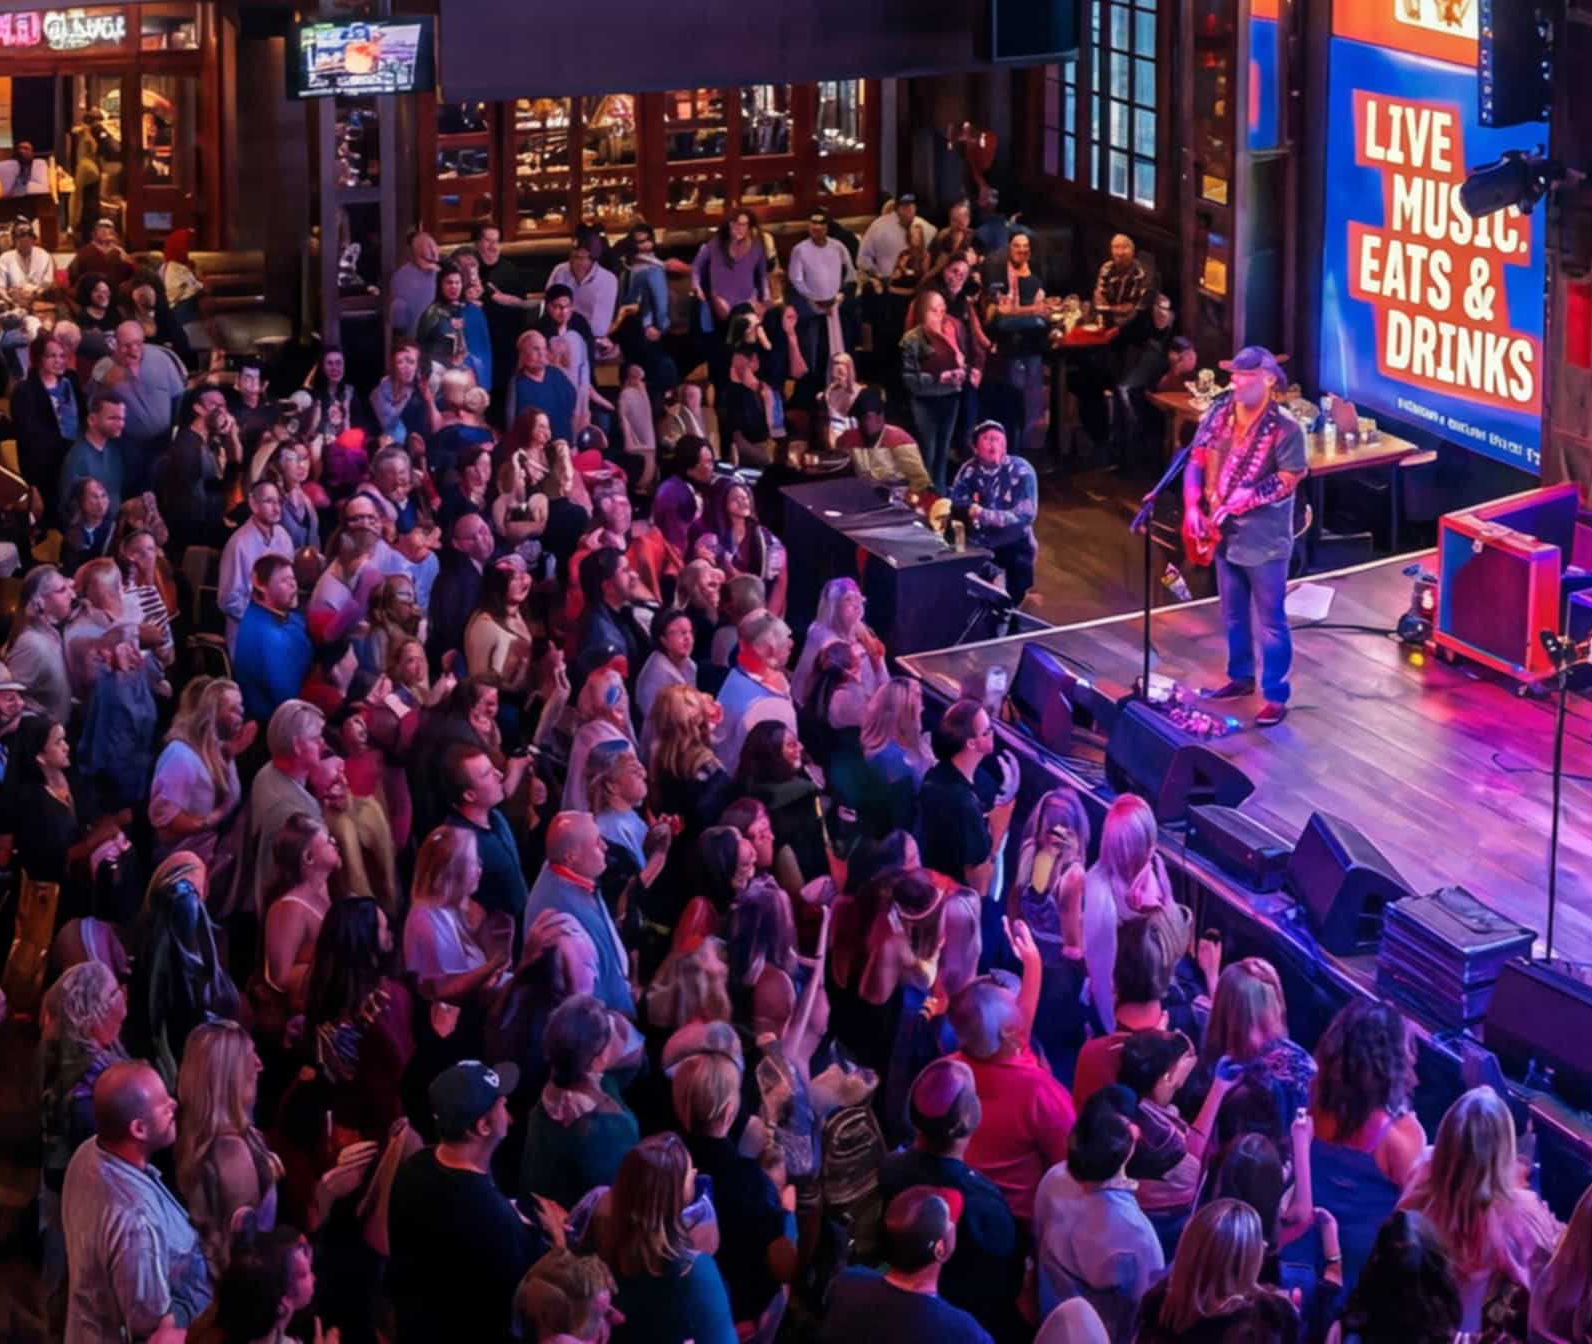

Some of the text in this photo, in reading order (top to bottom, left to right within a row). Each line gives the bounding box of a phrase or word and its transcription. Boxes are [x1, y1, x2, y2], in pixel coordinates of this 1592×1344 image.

[1365, 99, 1453, 173] LIVE
[1359, 233, 1495, 321] EATS &
[1386, 309, 1534, 402] DRINKS
